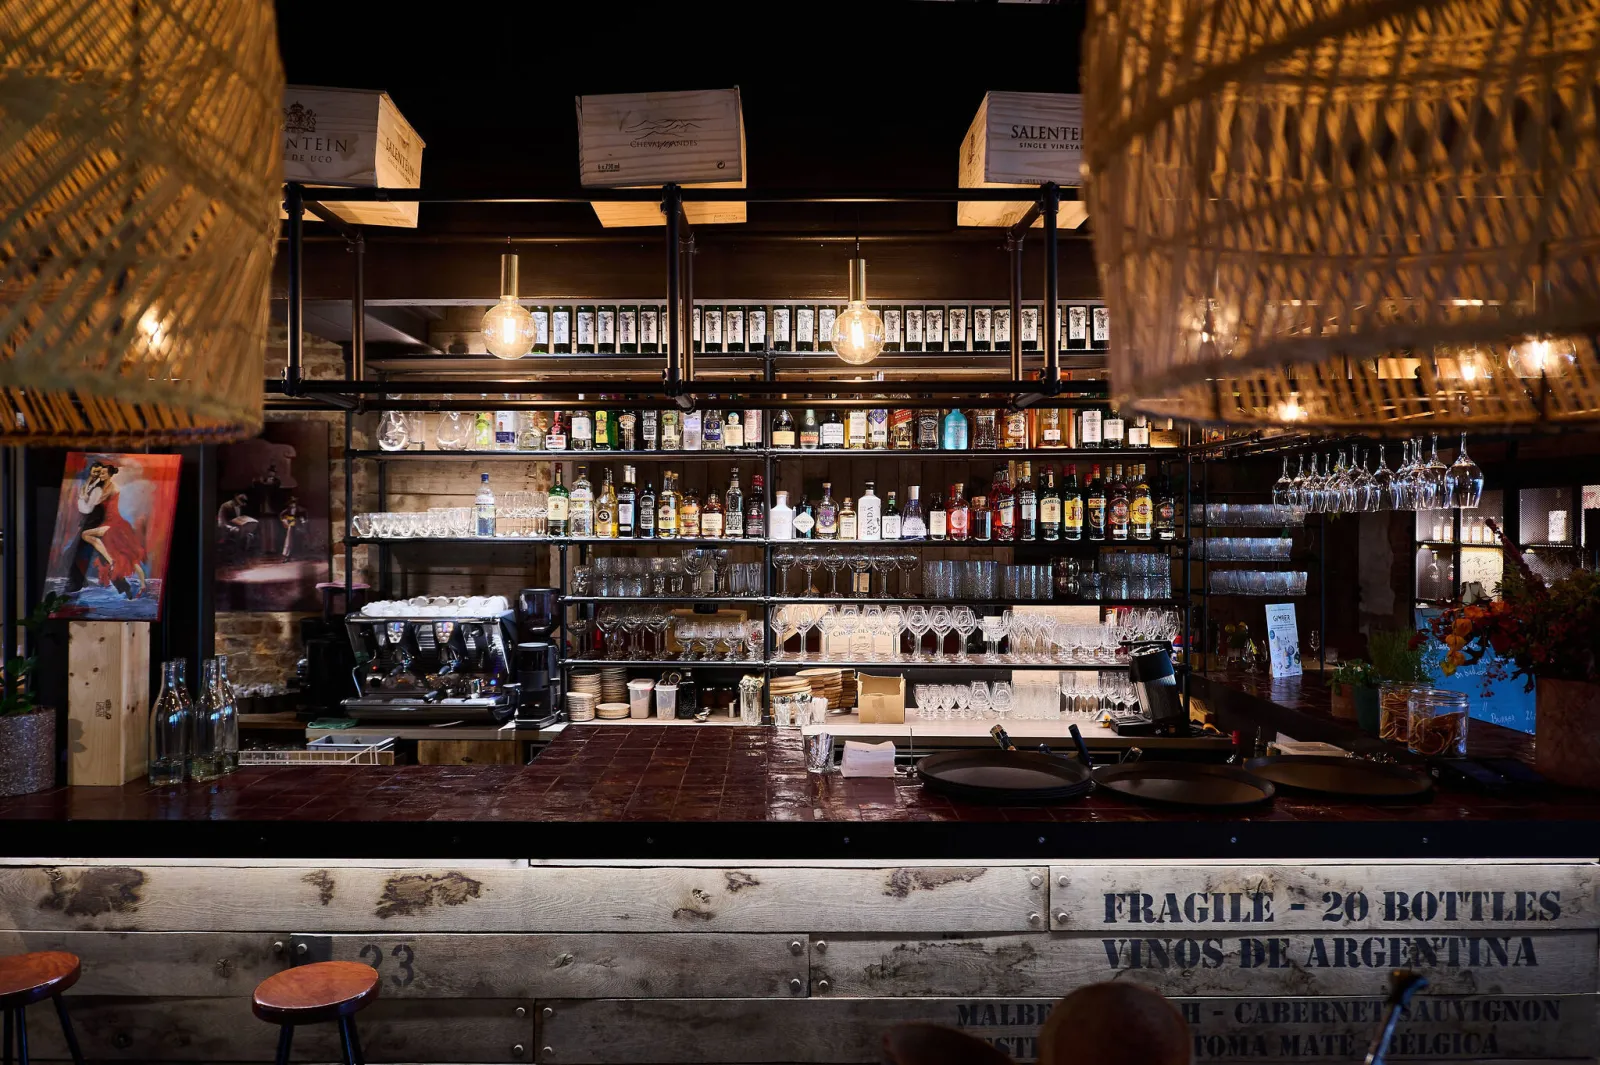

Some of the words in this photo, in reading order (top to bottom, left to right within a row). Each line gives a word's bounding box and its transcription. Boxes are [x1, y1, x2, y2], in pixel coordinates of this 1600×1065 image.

[286, 136, 348, 152] NTEIN
[1011, 125, 1084, 141] SALENTEI
[311, 155, 332, 163] UCO
[866, 506, 874, 536] PANDA
[1103, 892, 1274, 923] FRAGILE
[1322, 891, 1370, 923] 20
[1382, 891, 1561, 922] BOTTLES
[1102, 938, 1223, 969] VINOS
[1239, 938, 1290, 969] DE
[1304, 936, 1539, 968] ARGENTINA
[956, 1002, 1052, 1026] MALBE
[1233, 1001, 1387, 1025] CABERNET
[1401, 1000, 1561, 1023] SAUVIGNON
[1195, 1034, 1269, 1058] TOMA
